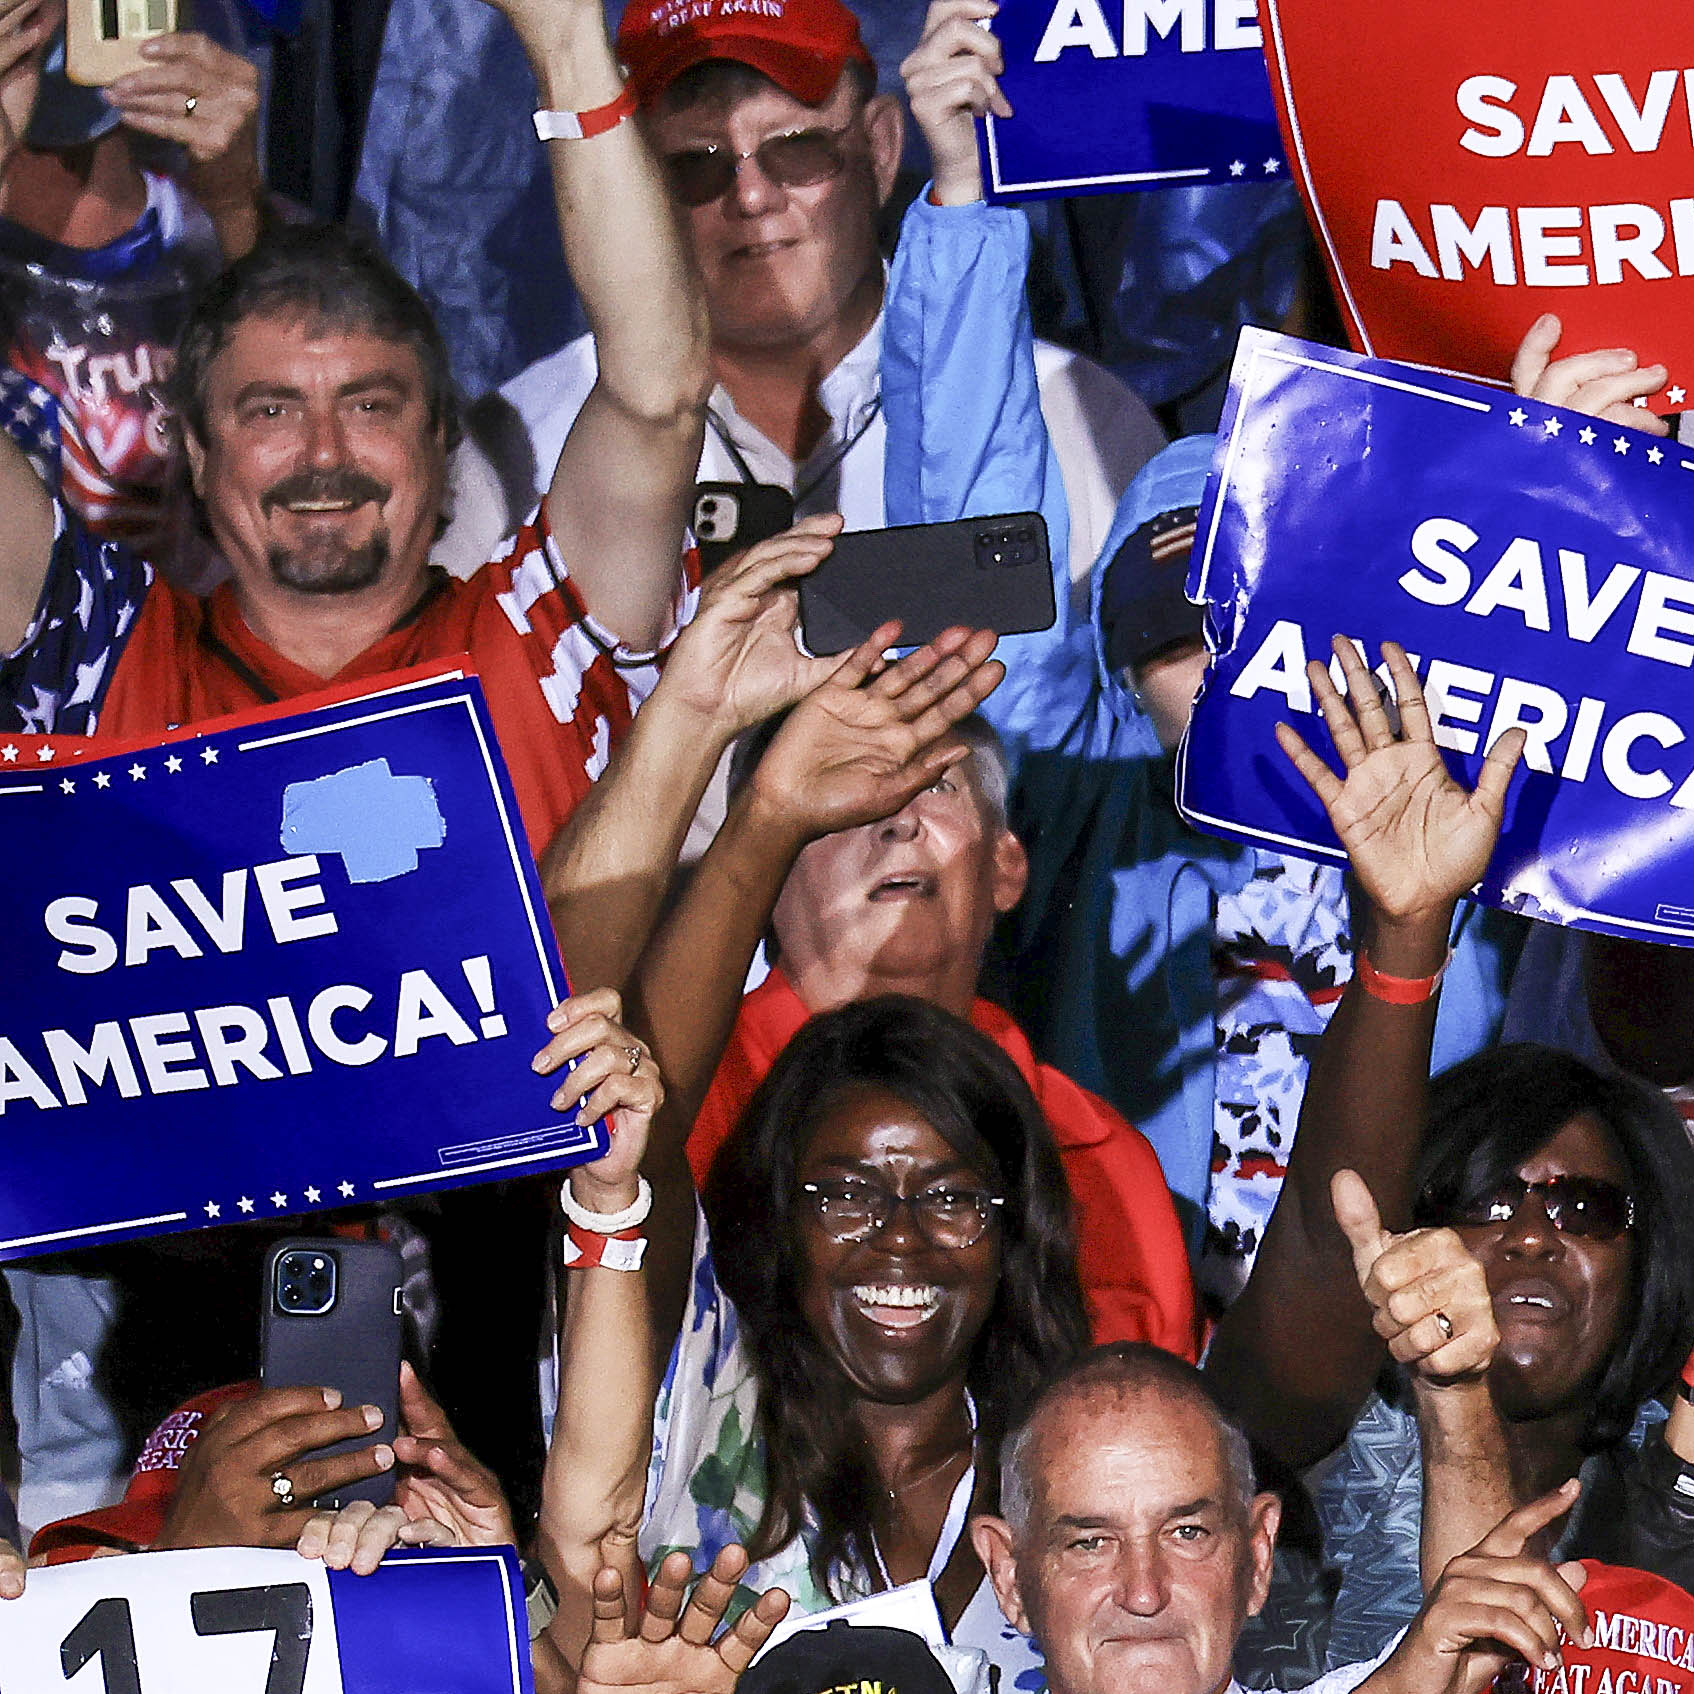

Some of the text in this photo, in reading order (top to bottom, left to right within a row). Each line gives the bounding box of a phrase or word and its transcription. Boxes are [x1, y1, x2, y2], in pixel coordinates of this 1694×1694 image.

[1034, 0, 1264, 62] AME
[45, 343, 153, 404] Tru
[44, 854, 340, 975] SAVE
[0, 955, 508, 1115] AMERICA!
